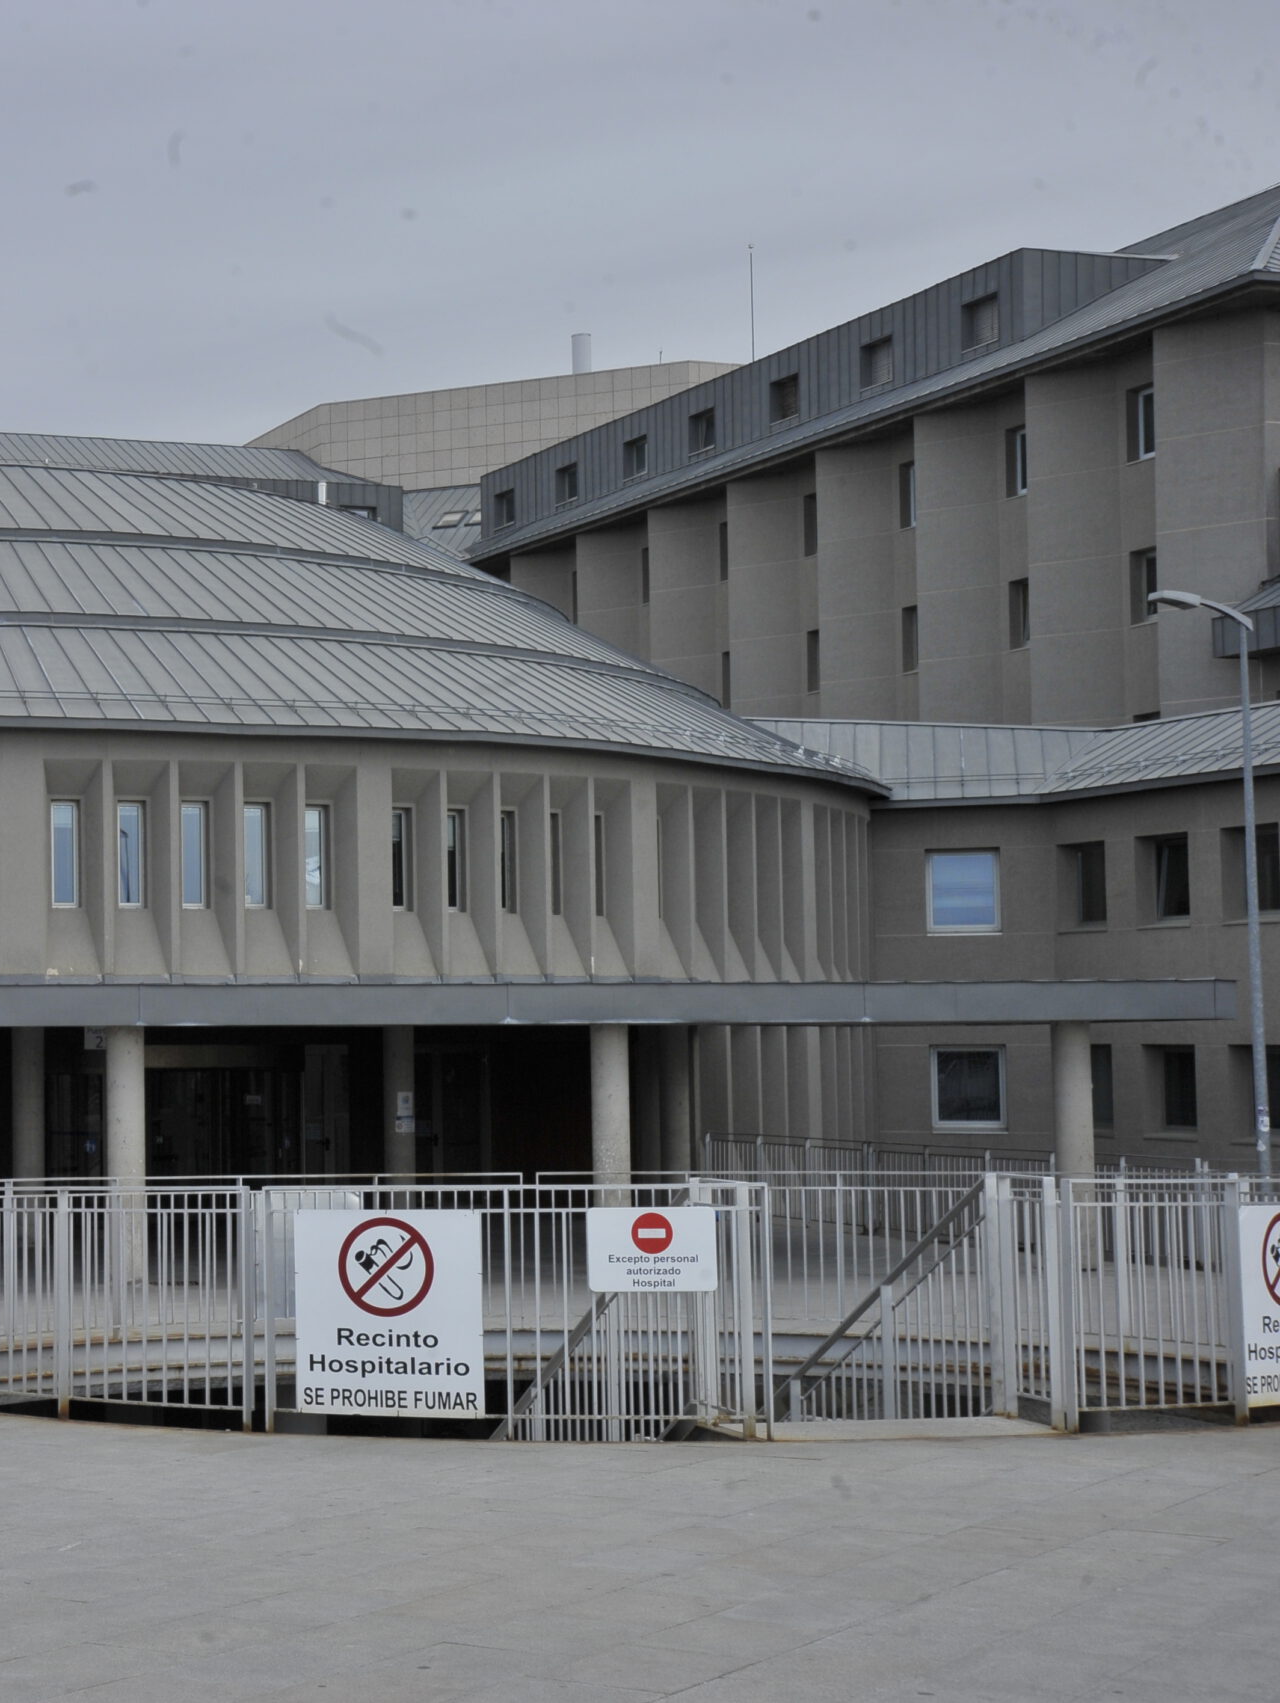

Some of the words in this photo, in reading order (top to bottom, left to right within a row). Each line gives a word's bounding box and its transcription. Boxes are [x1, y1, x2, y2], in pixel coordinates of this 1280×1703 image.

[95, 1035, 103, 1049] 2
[608, 1254, 650, 1265] Excepto
[653, 1254, 699, 1265] personal
[626, 1266, 681, 1275] autorizado
[632, 1278, 676, 1289] Hospital
[1262, 1315, 1280, 1334] Re
[336, 1327, 439, 1348] Recinto
[308, 1354, 470, 1378] Hospitalario
[1246, 1376, 1258, 1394] SE
[1260, 1374, 1280, 1393] PRO
[303, 1386, 325, 1406] SE
[331, 1388, 408, 1409] PROHIBE
[414, 1390, 478, 1411] FUMAR
